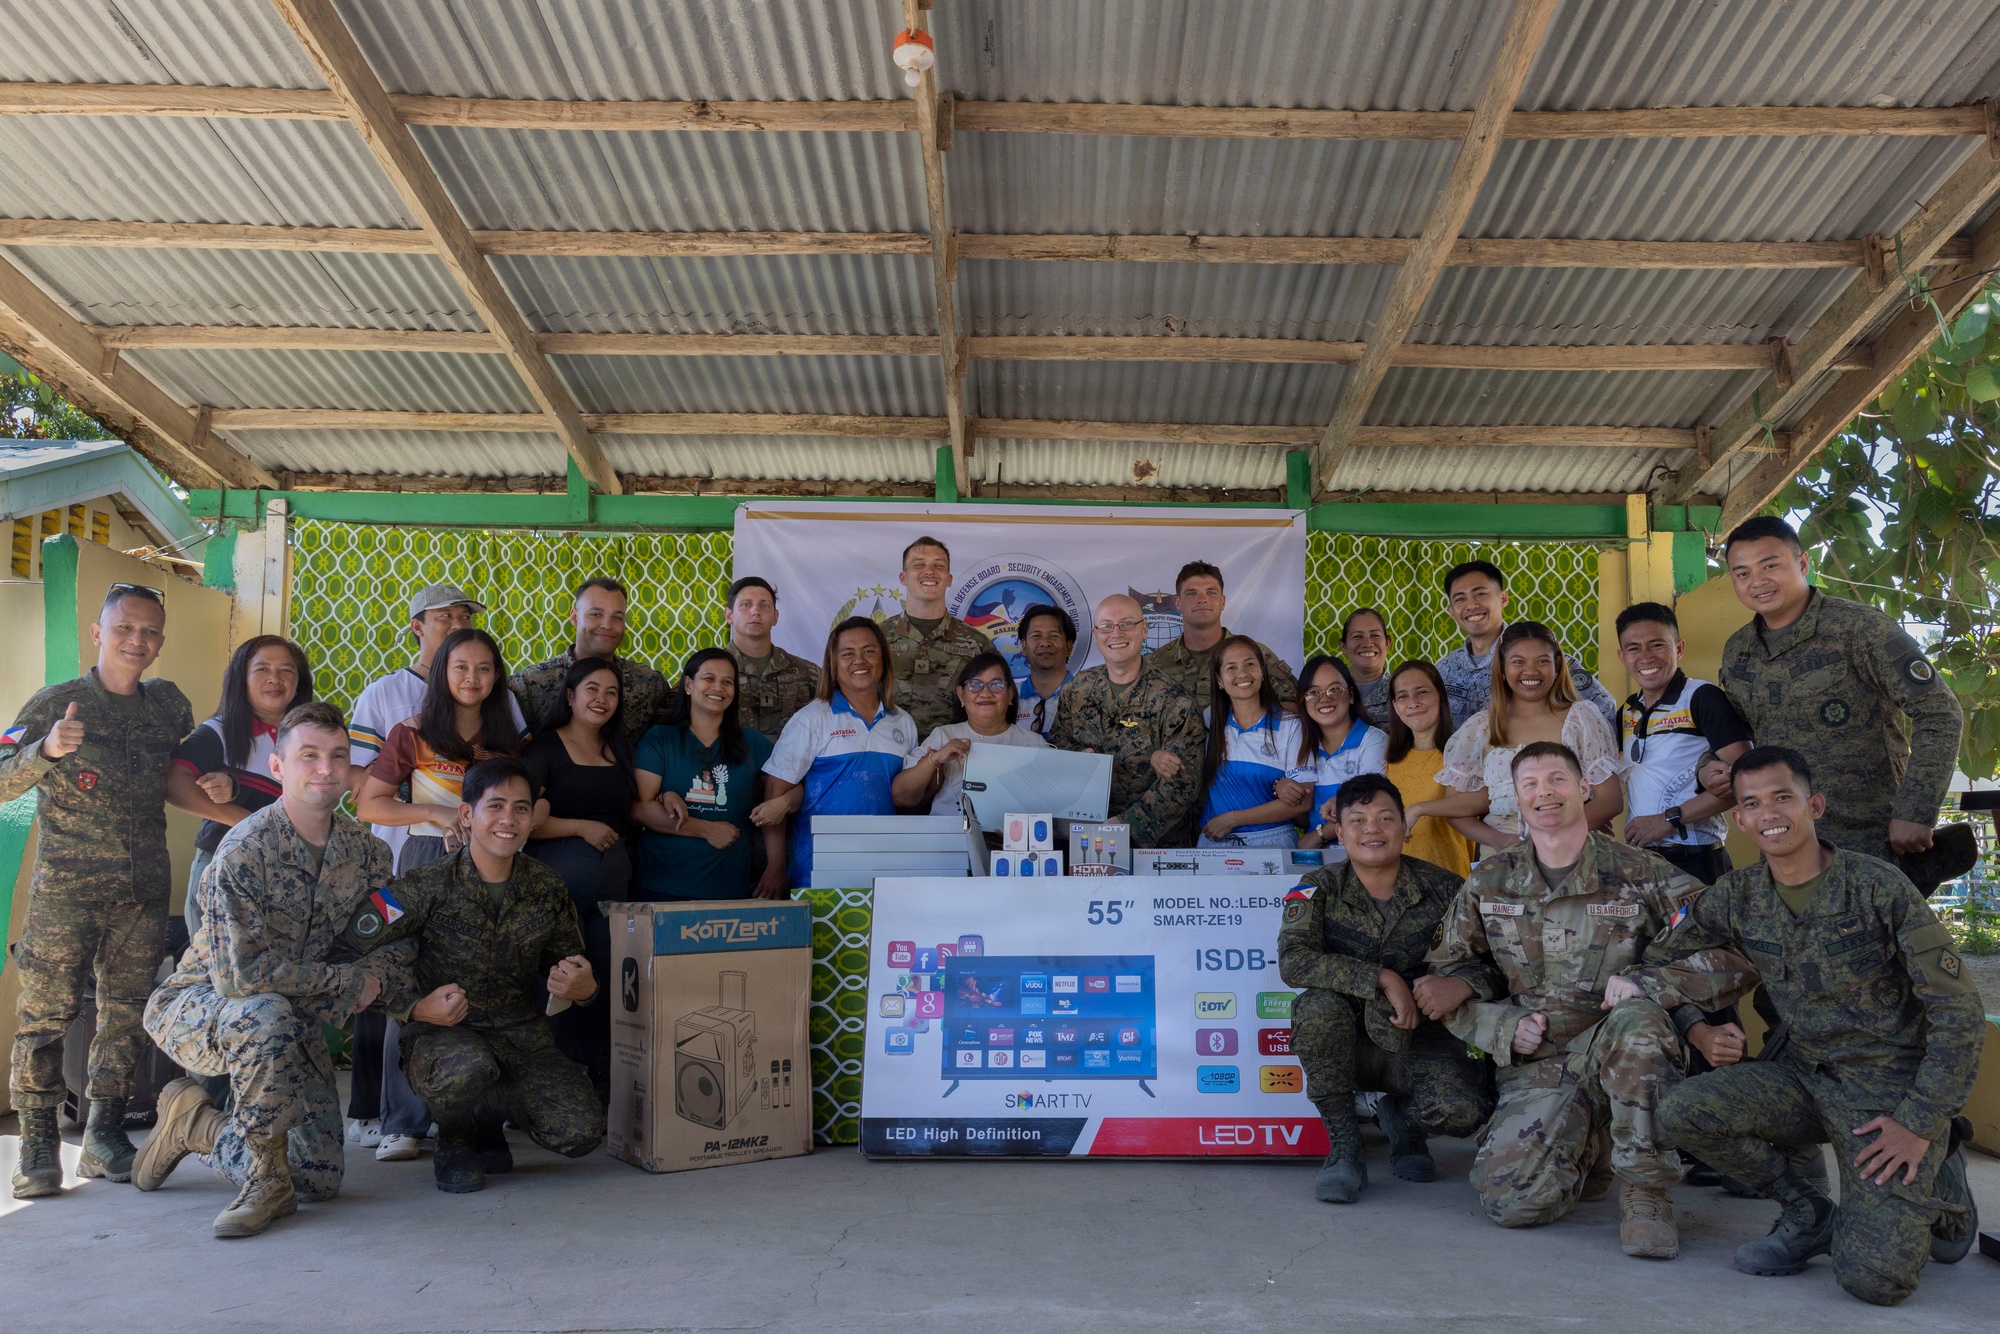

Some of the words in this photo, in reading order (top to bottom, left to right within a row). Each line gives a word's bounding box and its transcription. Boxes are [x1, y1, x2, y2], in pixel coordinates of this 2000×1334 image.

[955, 576, 979, 603] DEFENSE
[977, 564, 1001, 582] BOARD
[1008, 562, 1042, 577] SECURITY
[1041, 571, 1075, 608] ENGAGEMENT
[1800, 655, 1831, 674] ARMY
[830, 729, 856, 737] MATATAG
[1073, 865, 1108, 873] HDTV
[1153, 897, 1205, 909] MODEL
[1492, 904, 1516, 914] RAINES
[1615, 905, 1636, 915] FORCE
[434, 914, 478, 937] MARQUEZ
[525, 913, 550, 934] ARMY
[1153, 914, 1243, 926] SMART-ZE19
[896, 943, 907, 951] You
[1842, 933, 1876, 950] ARMY
[894, 953, 908, 961] Tube
[1196, 949, 1277, 972] ISDB-
[1199, 999, 1232, 1013] HDTV
[1263, 1000, 1291, 1008] Energy
[1056, 1032, 1075, 1042] TMZ
[1269, 1044, 1290, 1052] USB
[1118, 1055, 1141, 1063] Yachting
[1005, 1091, 1069, 1110] SMART
[1072, 1093, 1093, 1108] TV
[886, 1127, 916, 1140] LED
[924, 1127, 959, 1143] High
[966, 1127, 1041, 1140] Definition
[1199, 1125, 1255, 1145] LED
[1258, 1125, 1304, 1145] TV
[703, 1135, 769, 1153] PA-12MK2
[689, 1153, 723, 1162] PORTABLE
[724, 1150, 752, 1158] TROLLEY
[753, 1146, 783, 1154] SPEAKER
